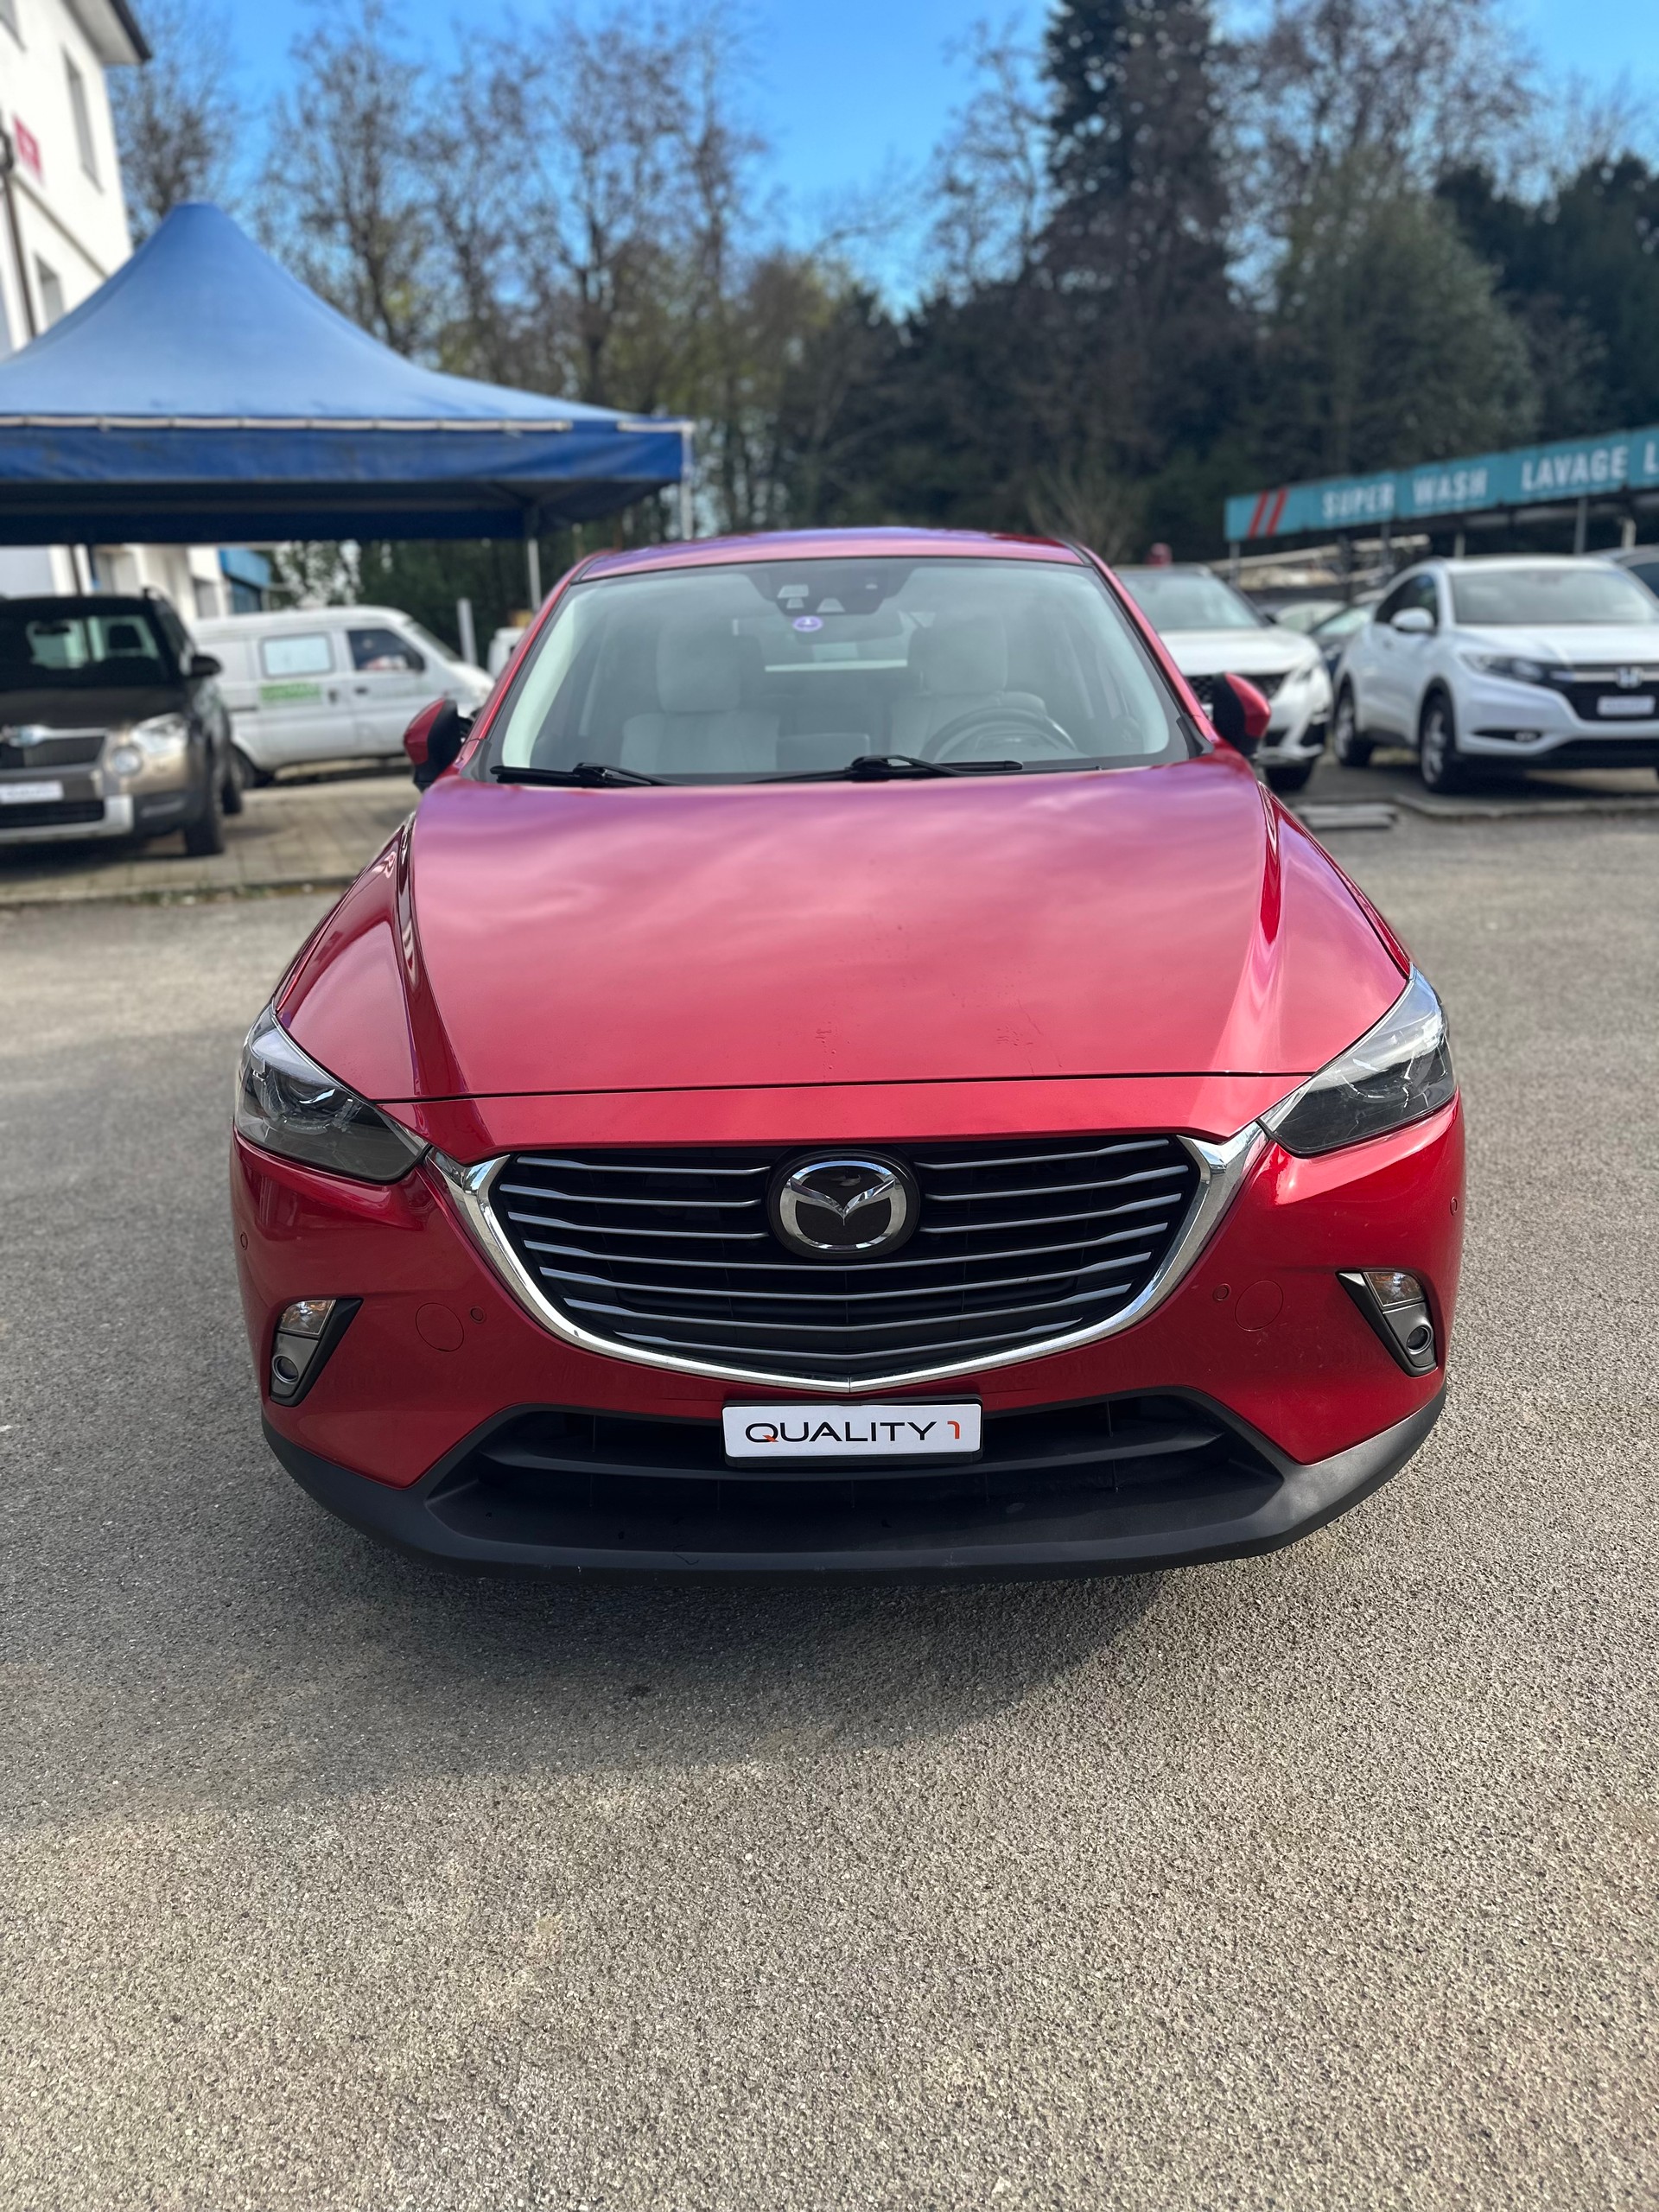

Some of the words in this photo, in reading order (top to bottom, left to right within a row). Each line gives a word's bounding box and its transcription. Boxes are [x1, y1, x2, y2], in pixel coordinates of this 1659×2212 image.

[1322, 482, 1395, 518] SUPER
[1413, 467, 1487, 506] WASH
[1521, 445, 1629, 491] LAVAGE
[745, 1421, 937, 1443] QUALITY
[947, 1421, 960, 1440] 1
